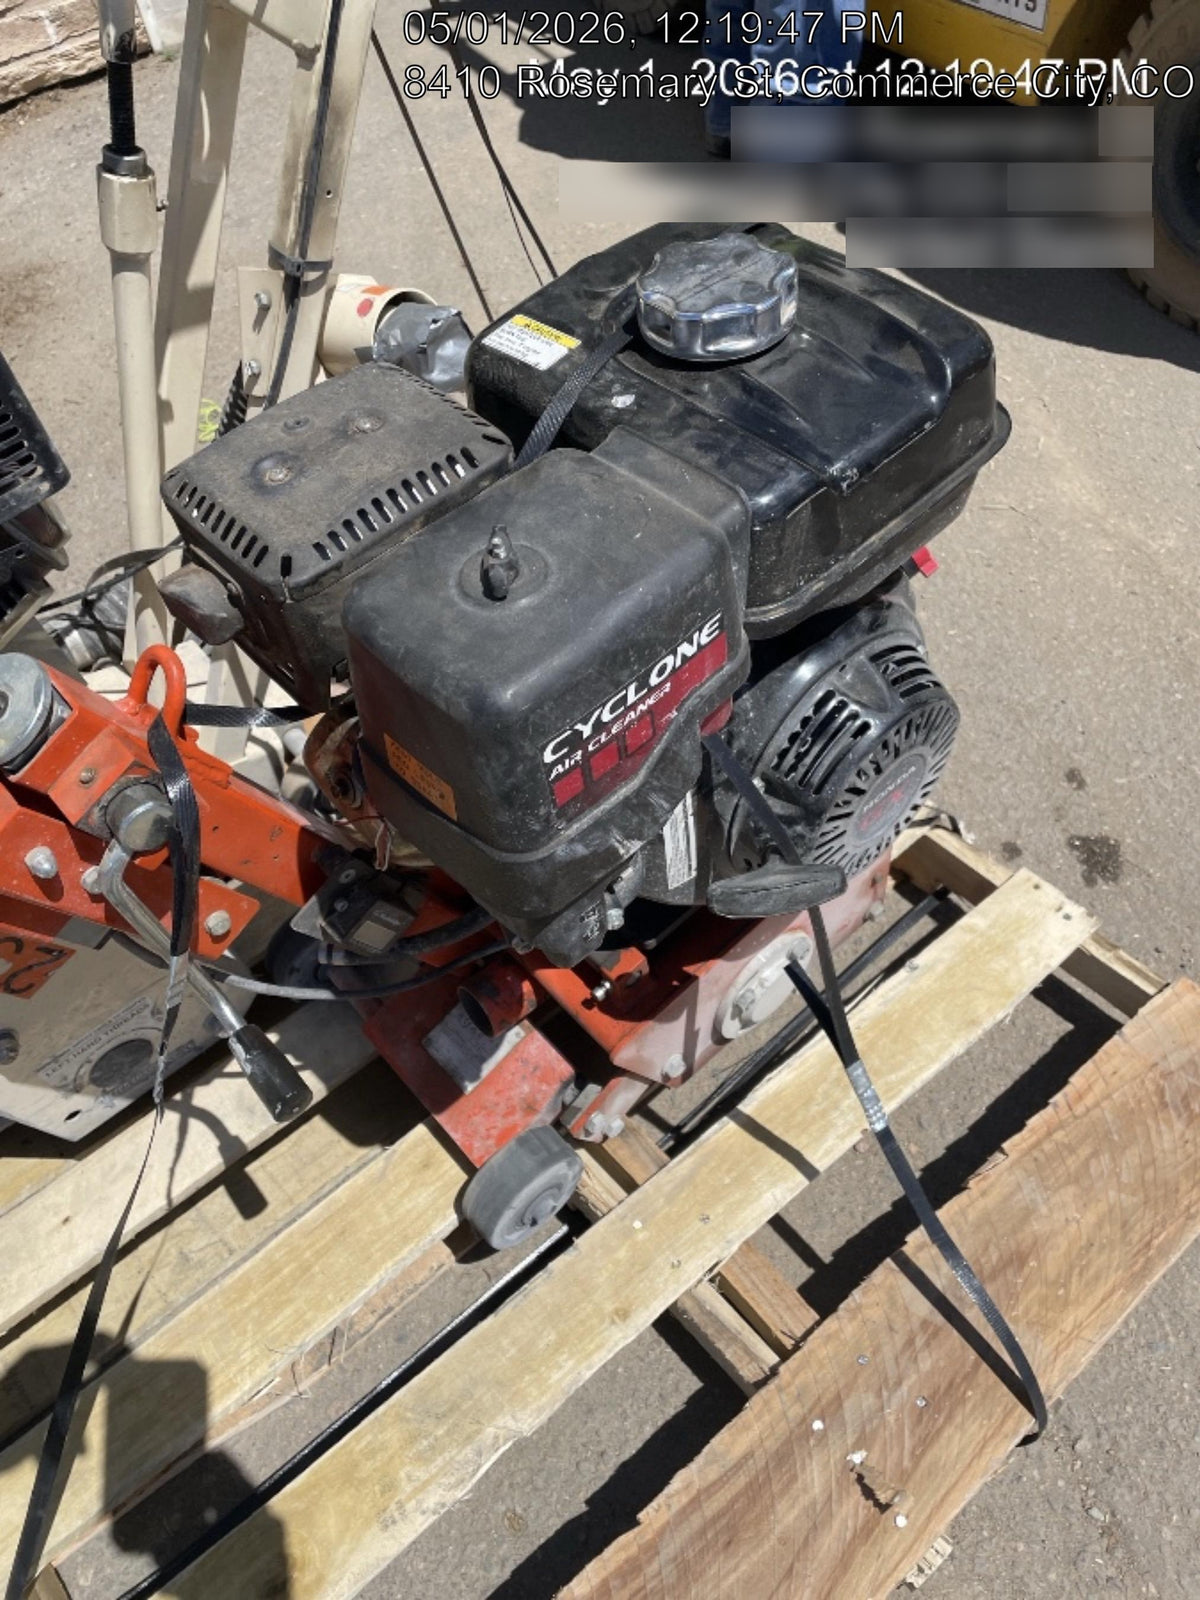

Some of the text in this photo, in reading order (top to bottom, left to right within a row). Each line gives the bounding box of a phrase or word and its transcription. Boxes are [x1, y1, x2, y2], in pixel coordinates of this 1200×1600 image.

[543, 612, 722, 764] CYCLONE
[549, 682, 672, 782] AIR CLEANER
